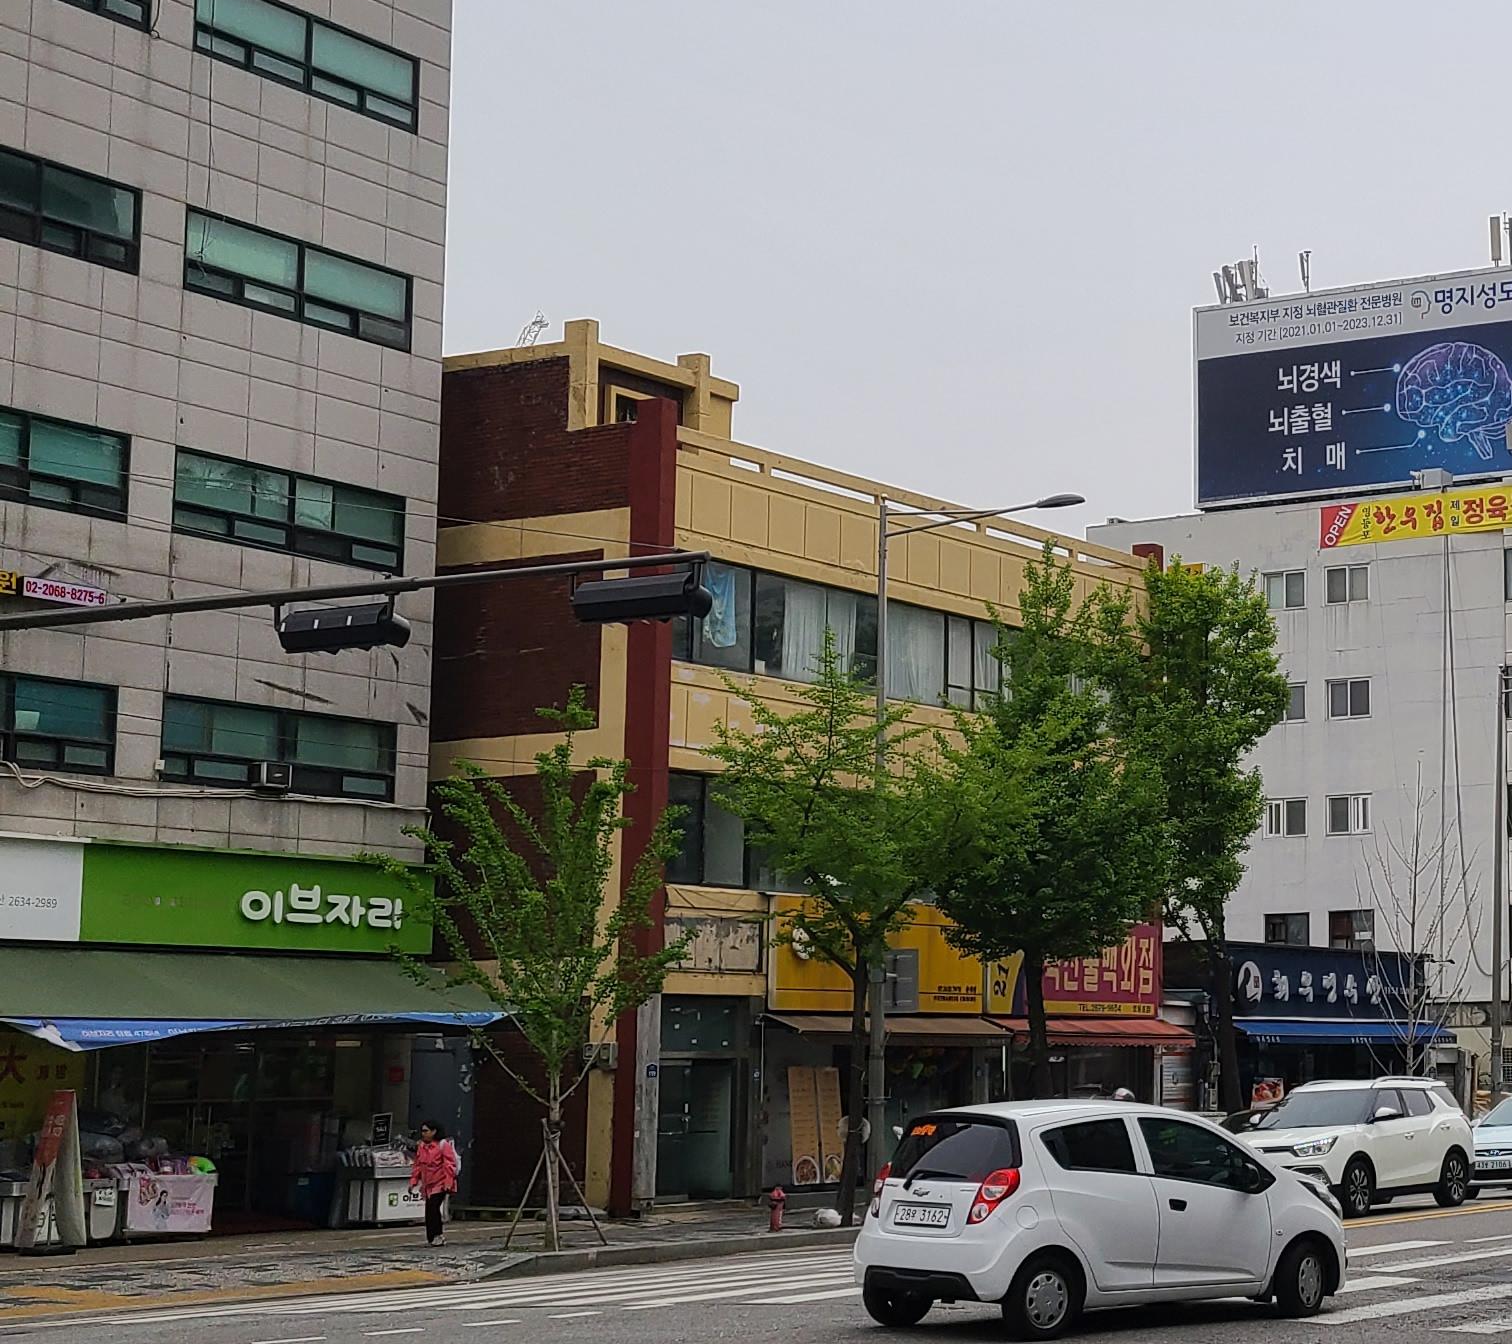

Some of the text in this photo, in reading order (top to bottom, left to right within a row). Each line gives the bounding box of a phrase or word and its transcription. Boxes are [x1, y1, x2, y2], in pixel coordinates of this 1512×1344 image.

[1228, 291, 1403, 328] 보건복지부 지정 뇌혈관질환 전문병원
[1235, 330, 1255, 345] 지정
[1257, 327, 1278, 343] 기간
[1277, 360, 1341, 394] 뇌경색
[1268, 402, 1333, 436] 뇌출혈
[1324, 506, 1352, 547] OPEN
[1360, 505, 1372, 540] 영등포
[1450, 500, 1461, 527] 제일
[8, 895, 58, 909] 2634-2989
[239, 883, 402, 930] 이브자리
[919, 1210, 944, 1222] 3162
